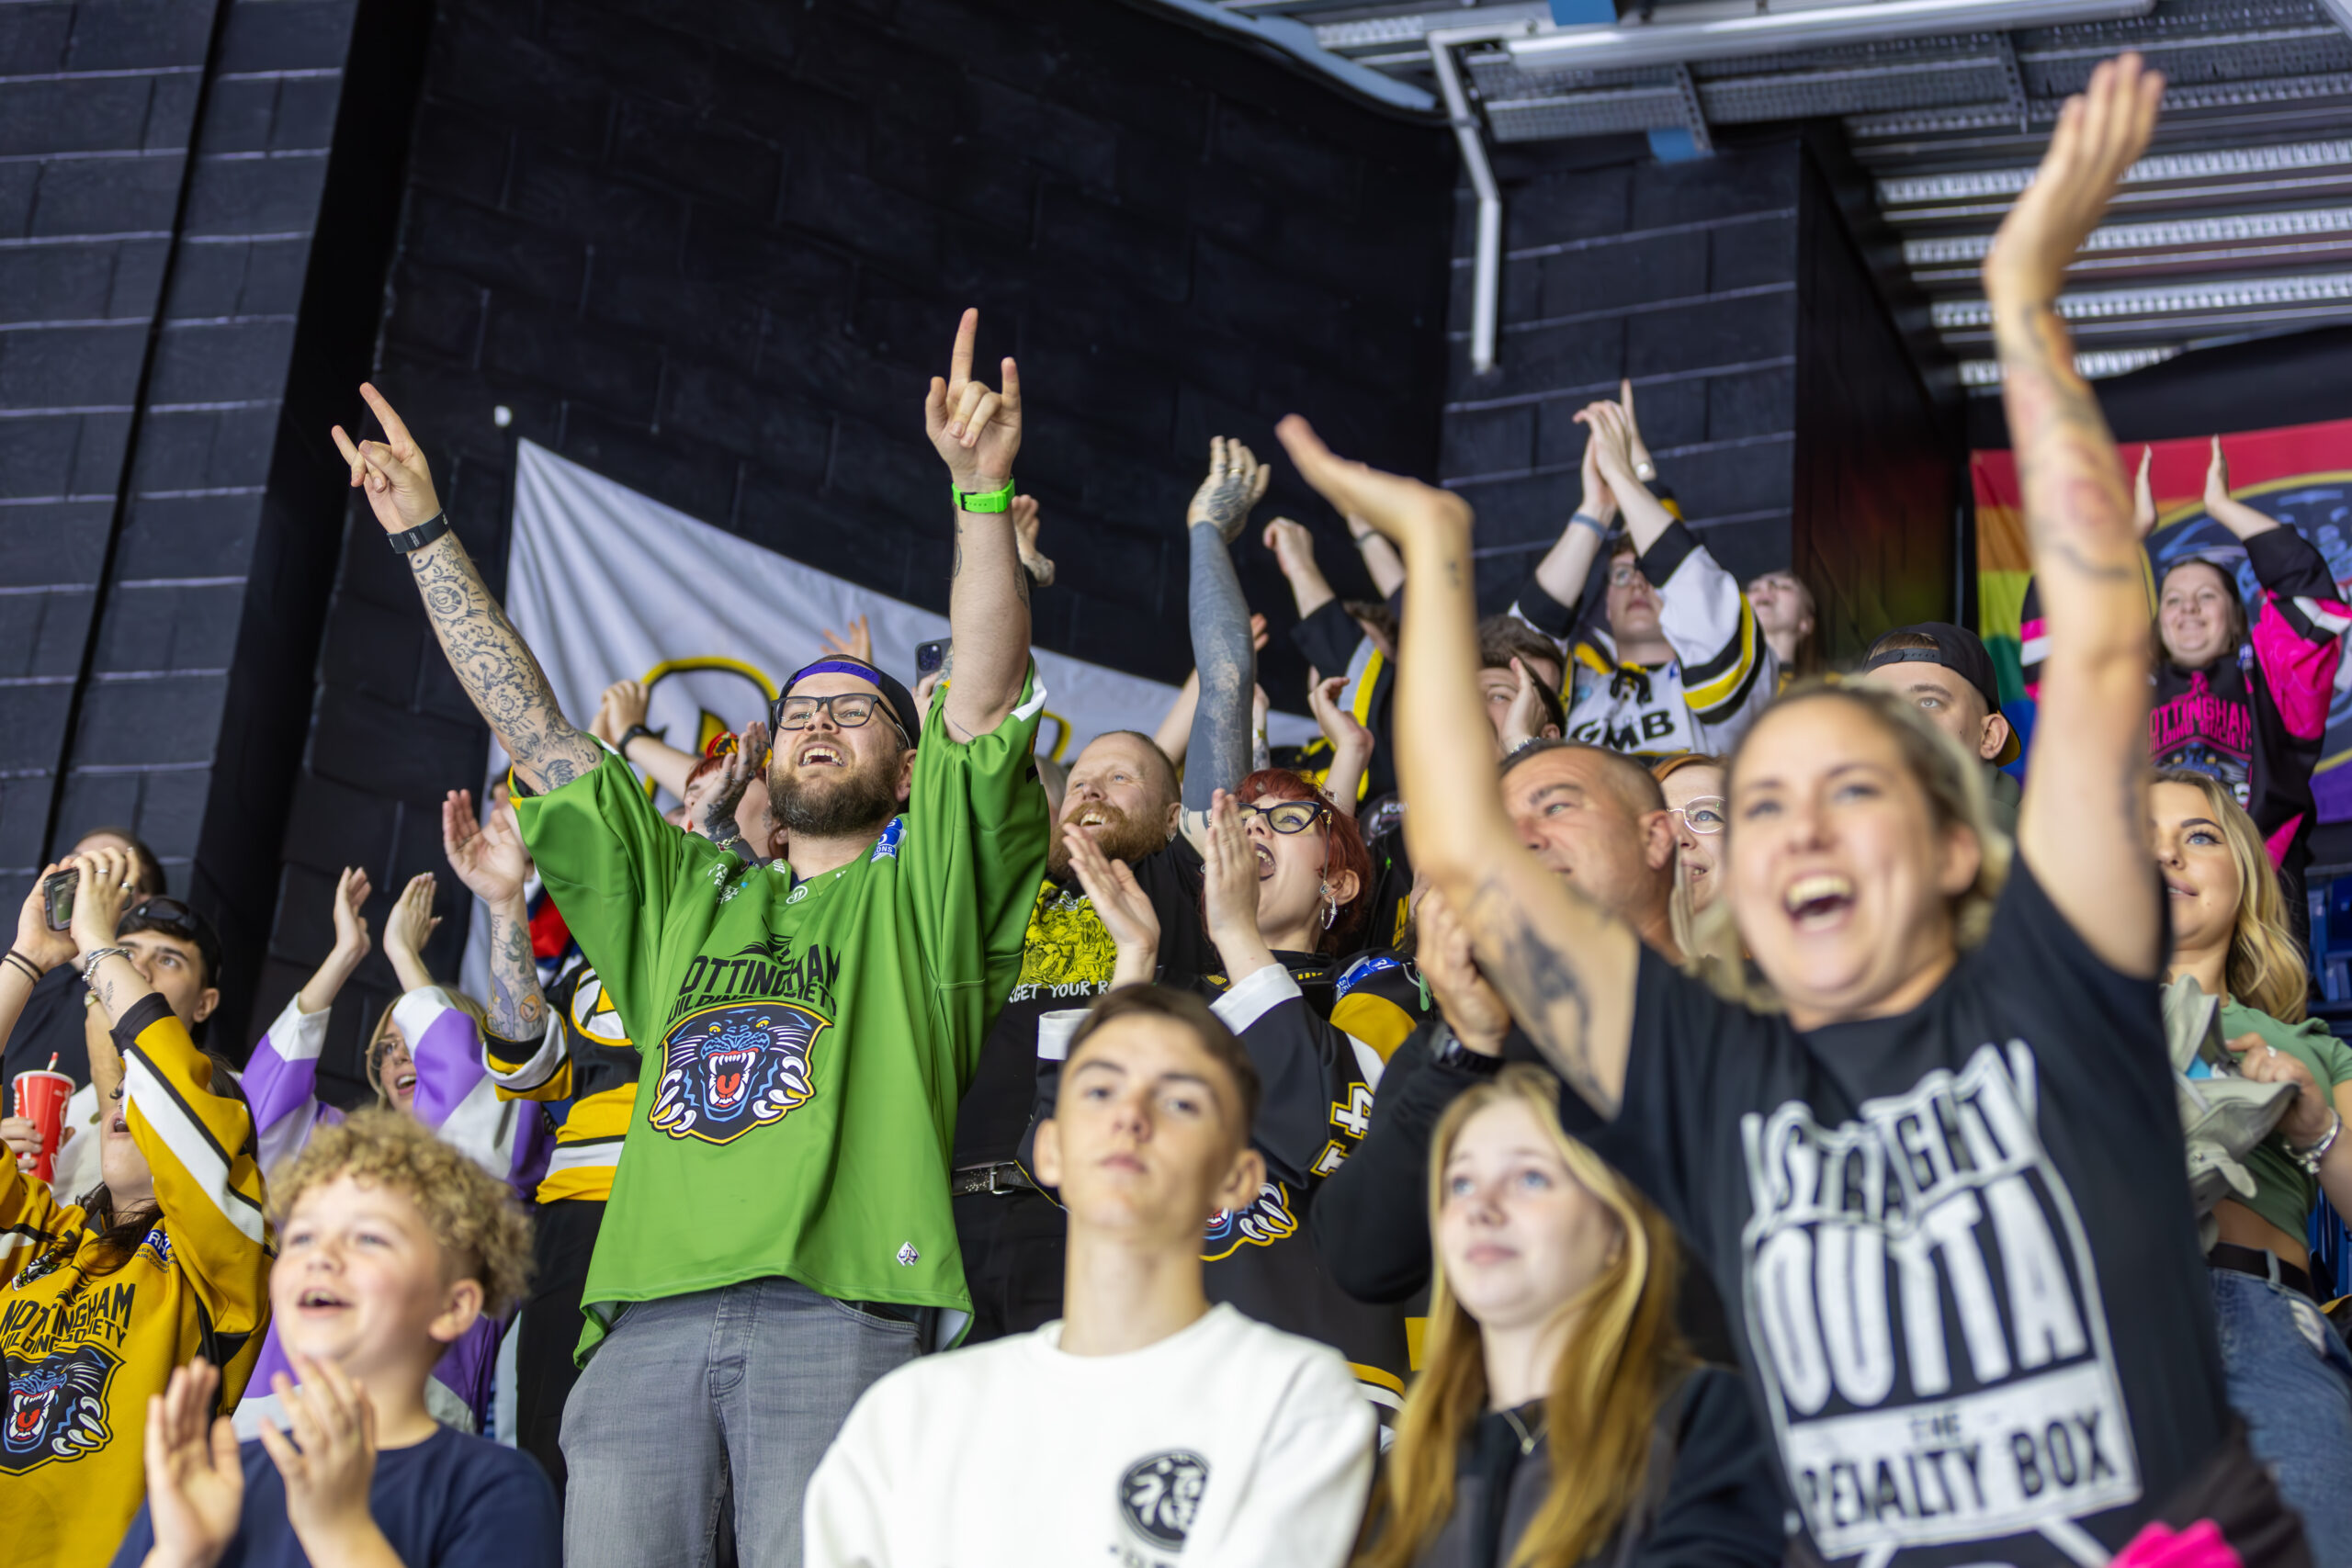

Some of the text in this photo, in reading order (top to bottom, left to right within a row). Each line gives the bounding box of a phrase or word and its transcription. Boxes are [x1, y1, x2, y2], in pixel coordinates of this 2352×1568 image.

[1571, 709, 1675, 752] GMB
[1008, 982, 1042, 1004] GET
[1048, 980, 1091, 998] YOUR
[1753, 1176, 2089, 1416] OUTTA
[2007, 1410, 2116, 1499] BOX
